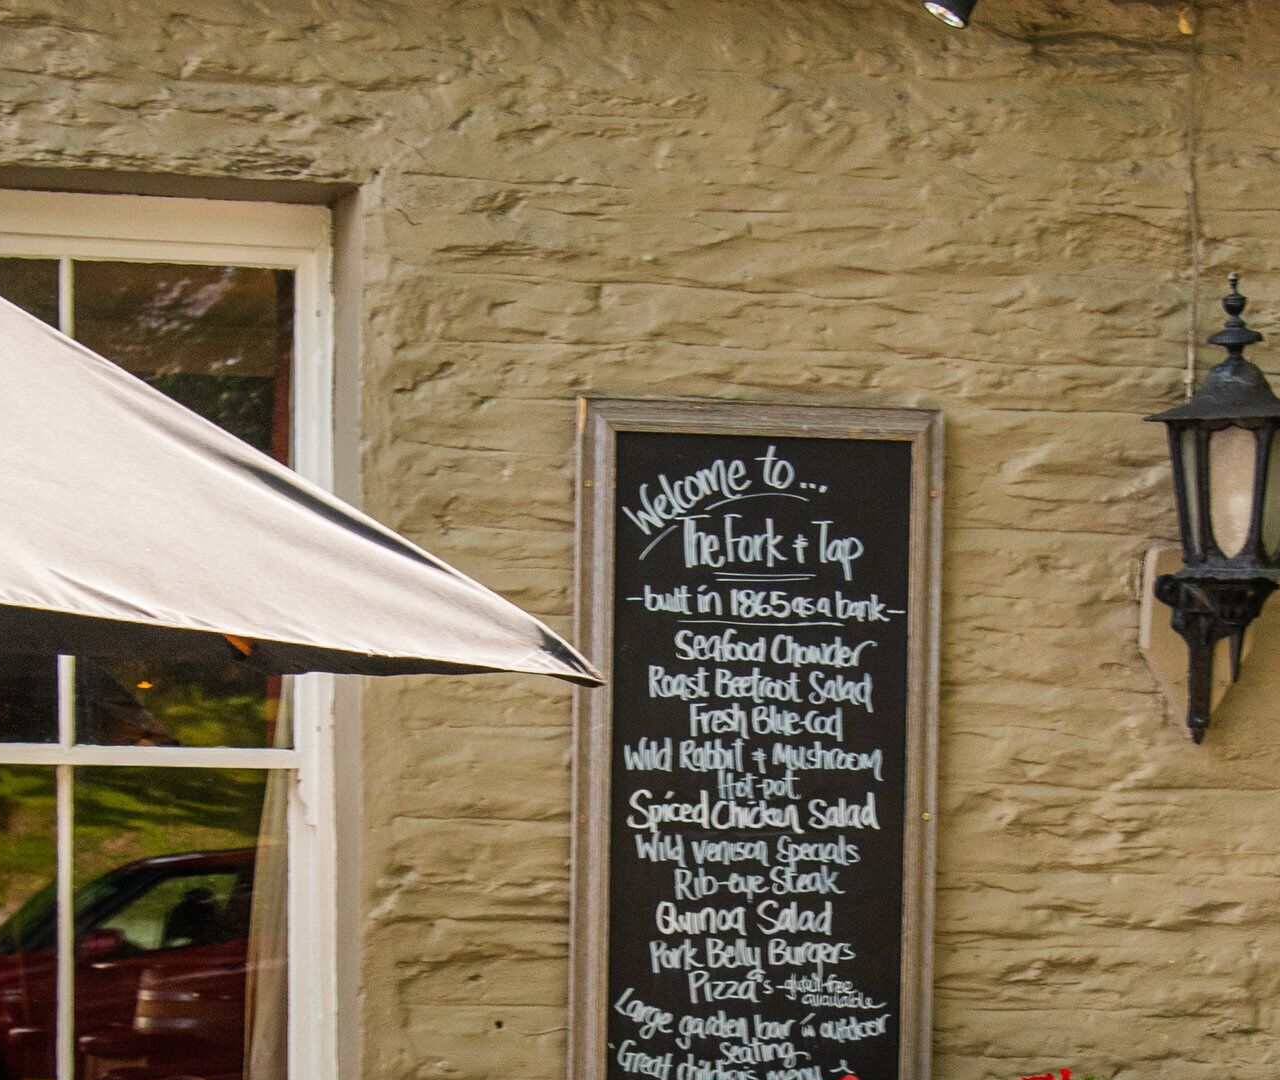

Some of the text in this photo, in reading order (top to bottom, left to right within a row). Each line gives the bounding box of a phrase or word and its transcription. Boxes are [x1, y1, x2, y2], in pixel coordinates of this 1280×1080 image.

[622, 459, 752, 535] Welcome
[673, 514, 725, 568] The
[723, 514, 788, 567] Fork
[811, 520, 864, 581] Tap
[697, 584, 723, 615] in
[730, 588, 792, 618] 1865
[791, 598, 817, 617] as
[817, 598, 833, 617] a
[673, 628, 878, 668] Seafood Chowder
[648, 664, 874, 713] Roast Beetroot Salad
[689, 702, 750, 740] Fresh
[623, 736, 673, 772] Wild
[679, 737, 746, 773] Rabbit
[626, 788, 881, 834] Spiced Chicken Salad
[634, 832, 688, 868] Wild
[775, 834, 861, 873] Specials
[769, 864, 846, 895] Steak
[655, 899, 832, 936] Quinoa Salad
[649, 937, 856, 981] Pork Belly Burgers
[614, 987, 674, 1039] Large
[675, 1010, 749, 1050] garden
[753, 1014, 796, 1040] bar
[820, 1013, 891, 1043] outdoor
[801, 991, 887, 1009] available
